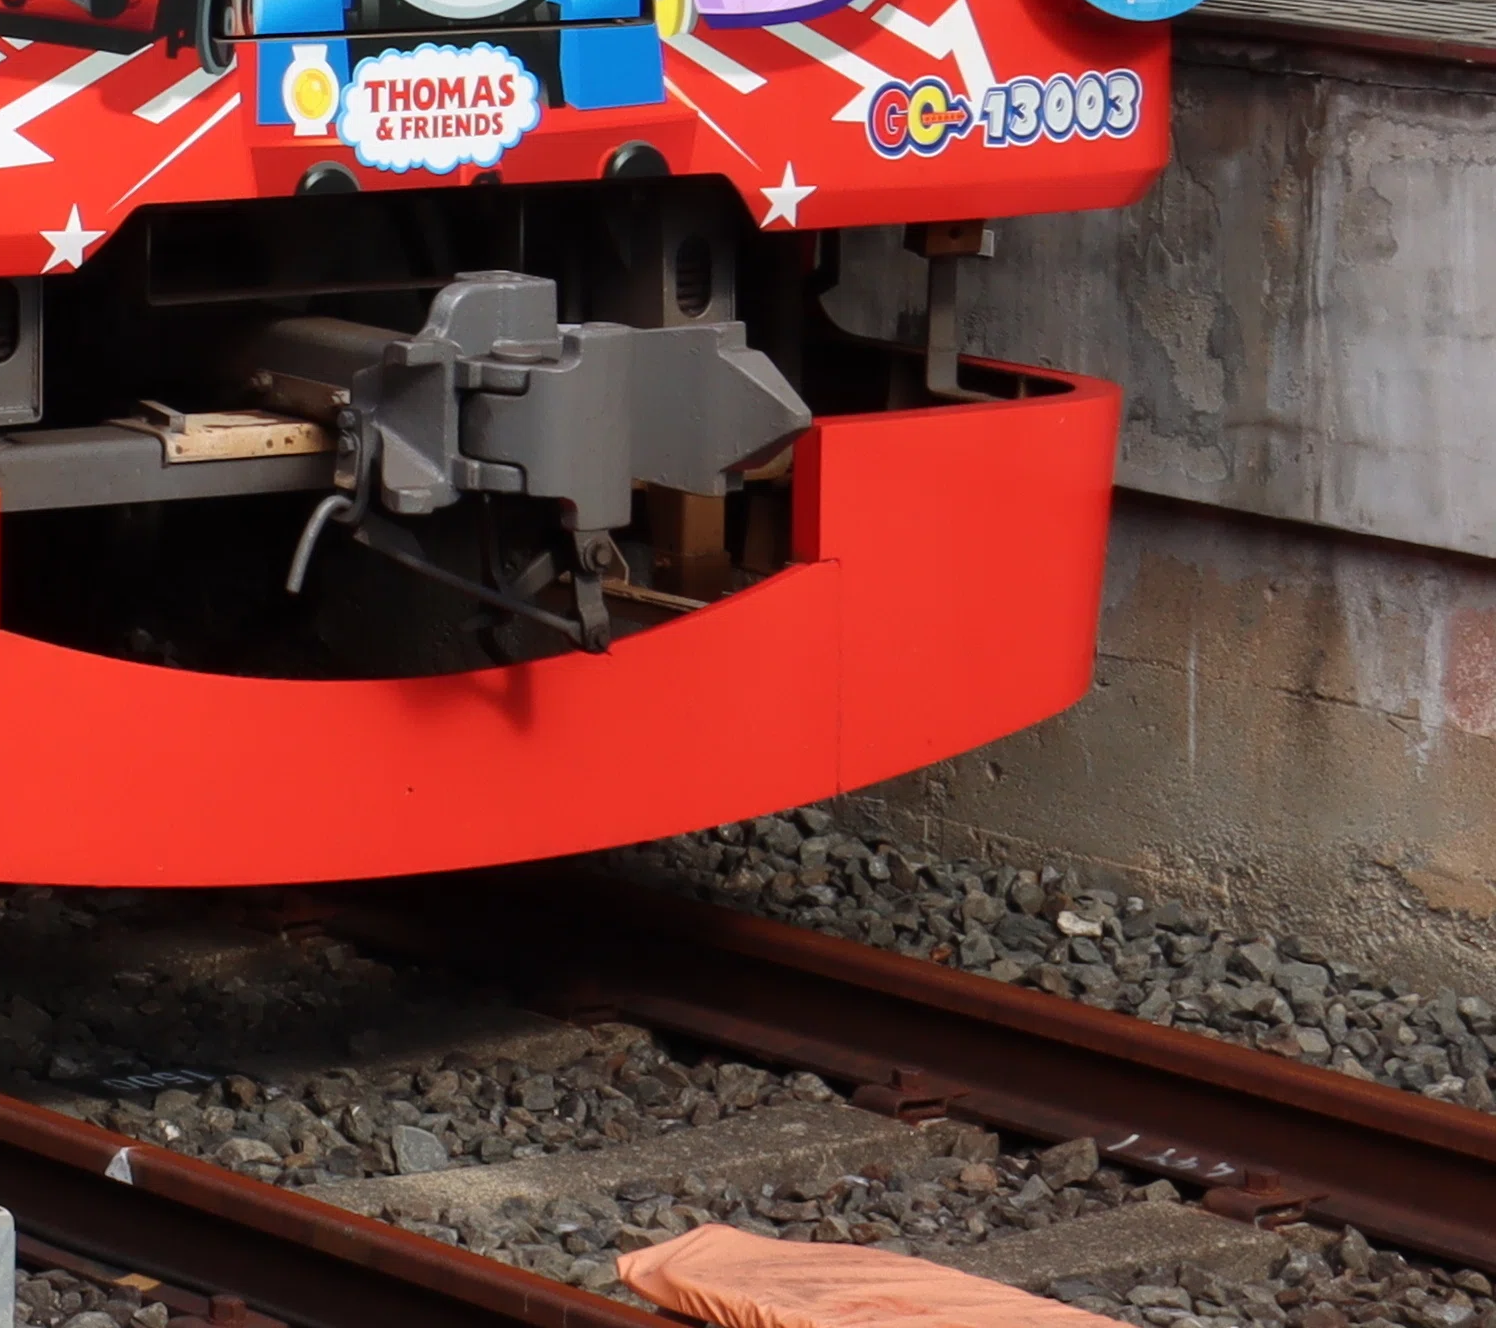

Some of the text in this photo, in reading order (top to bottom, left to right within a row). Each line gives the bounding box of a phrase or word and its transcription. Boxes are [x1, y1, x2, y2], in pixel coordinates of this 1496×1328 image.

[364, 74, 515, 113] THOMAS
[981, 71, 1141, 143] 13003
[376, 112, 504, 141] & FRIENDS
